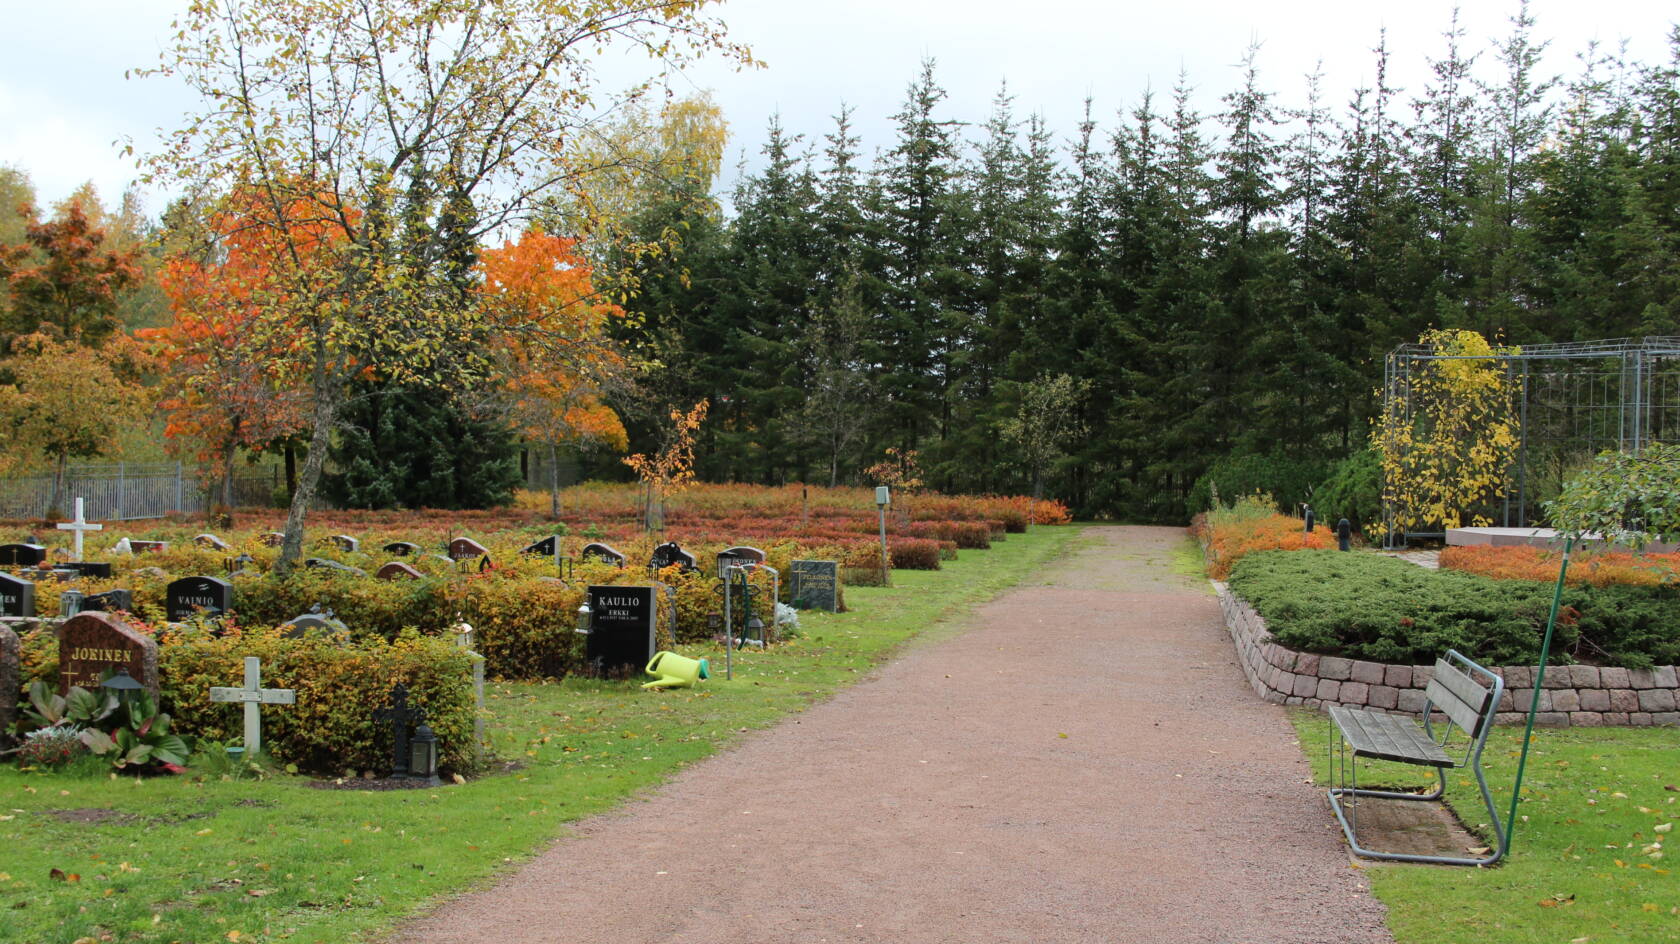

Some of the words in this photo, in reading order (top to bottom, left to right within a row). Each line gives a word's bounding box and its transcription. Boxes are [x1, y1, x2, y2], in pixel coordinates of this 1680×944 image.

[178, 595, 214, 605] VAINIO
[599, 596, 640, 607] KAULIO
[71, 647, 132, 663] JOKINEN
